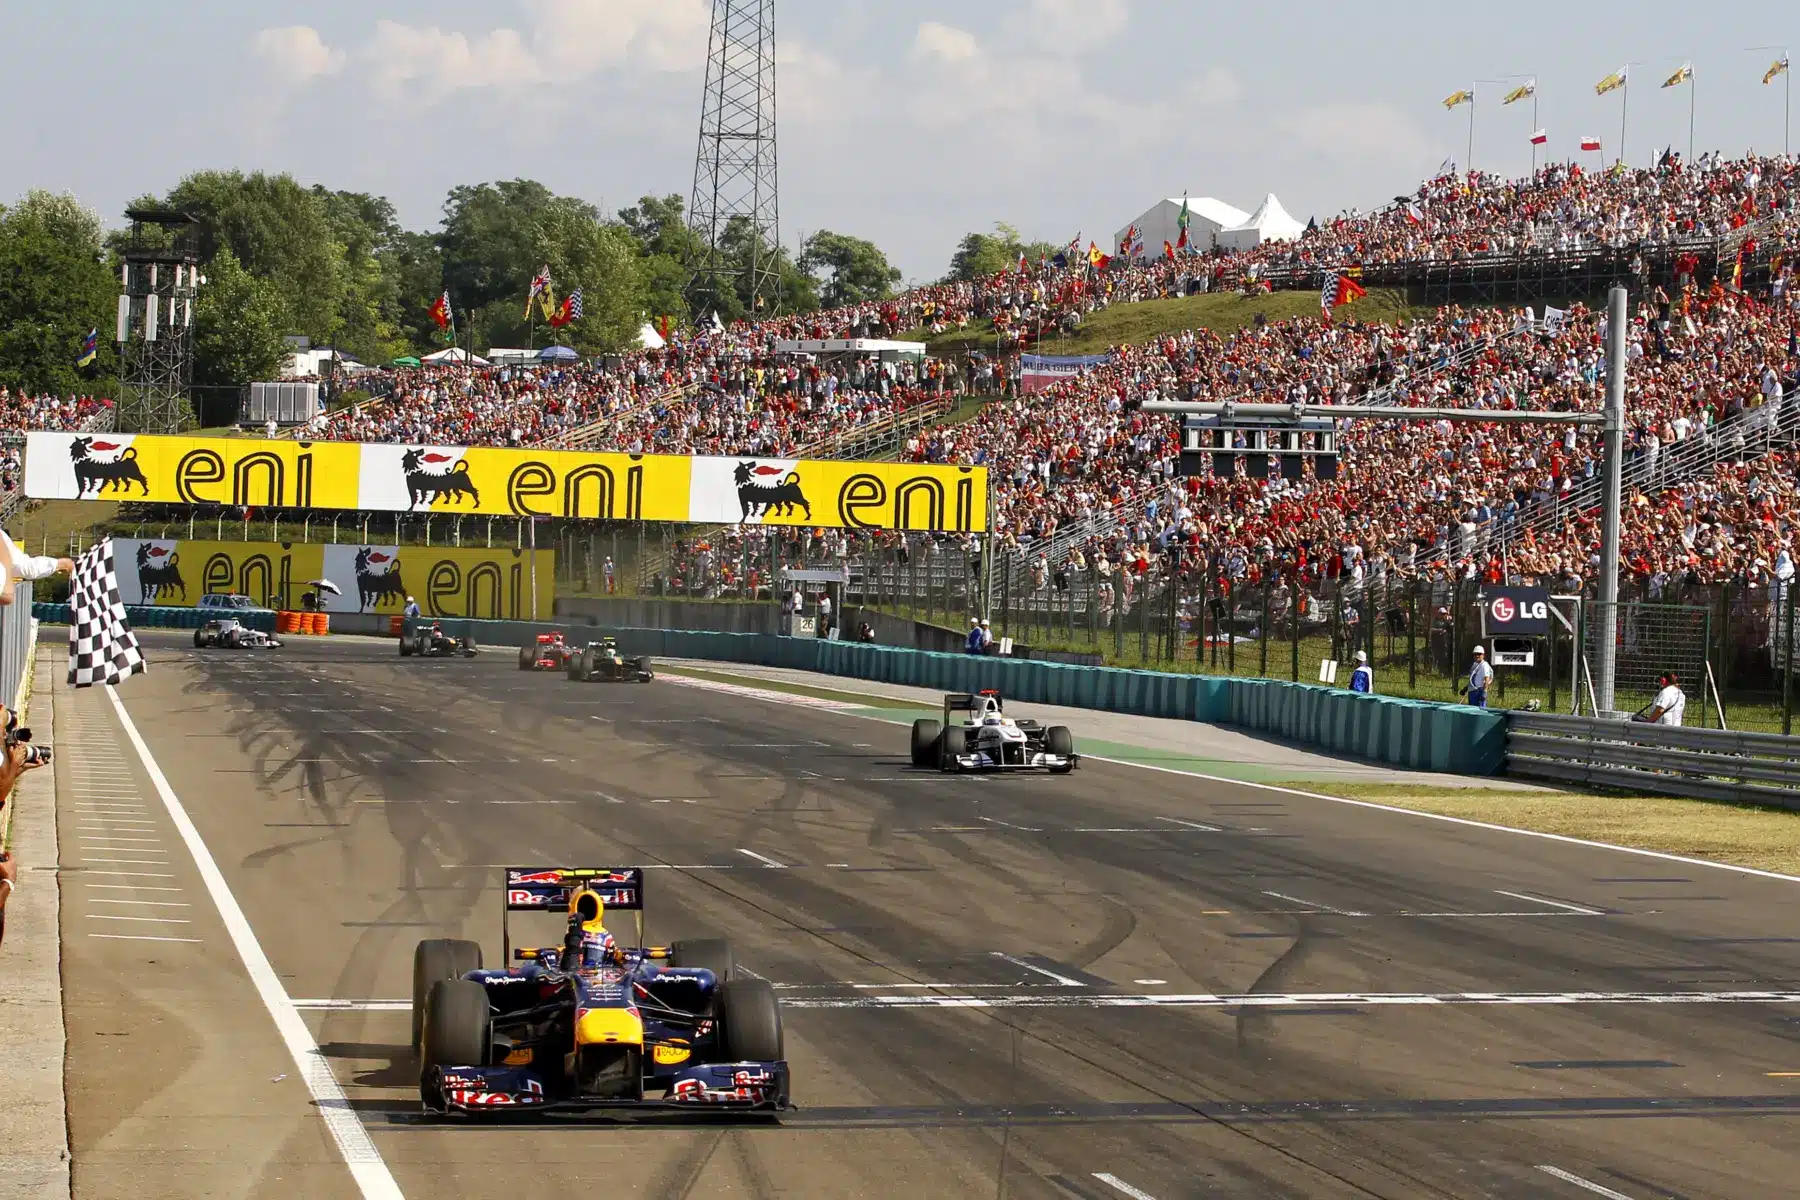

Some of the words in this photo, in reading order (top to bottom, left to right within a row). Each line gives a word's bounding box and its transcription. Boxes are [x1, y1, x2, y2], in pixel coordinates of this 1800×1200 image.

[176, 442, 312, 507] eni
[507, 455, 643, 520] eni
[838, 467, 972, 532] eni
[203, 541, 292, 610] eni
[427, 548, 522, 619] eni
[802, 619, 814, 630] 26
[1520, 601, 1547, 619] LG
[603, 888, 636, 904] ull
